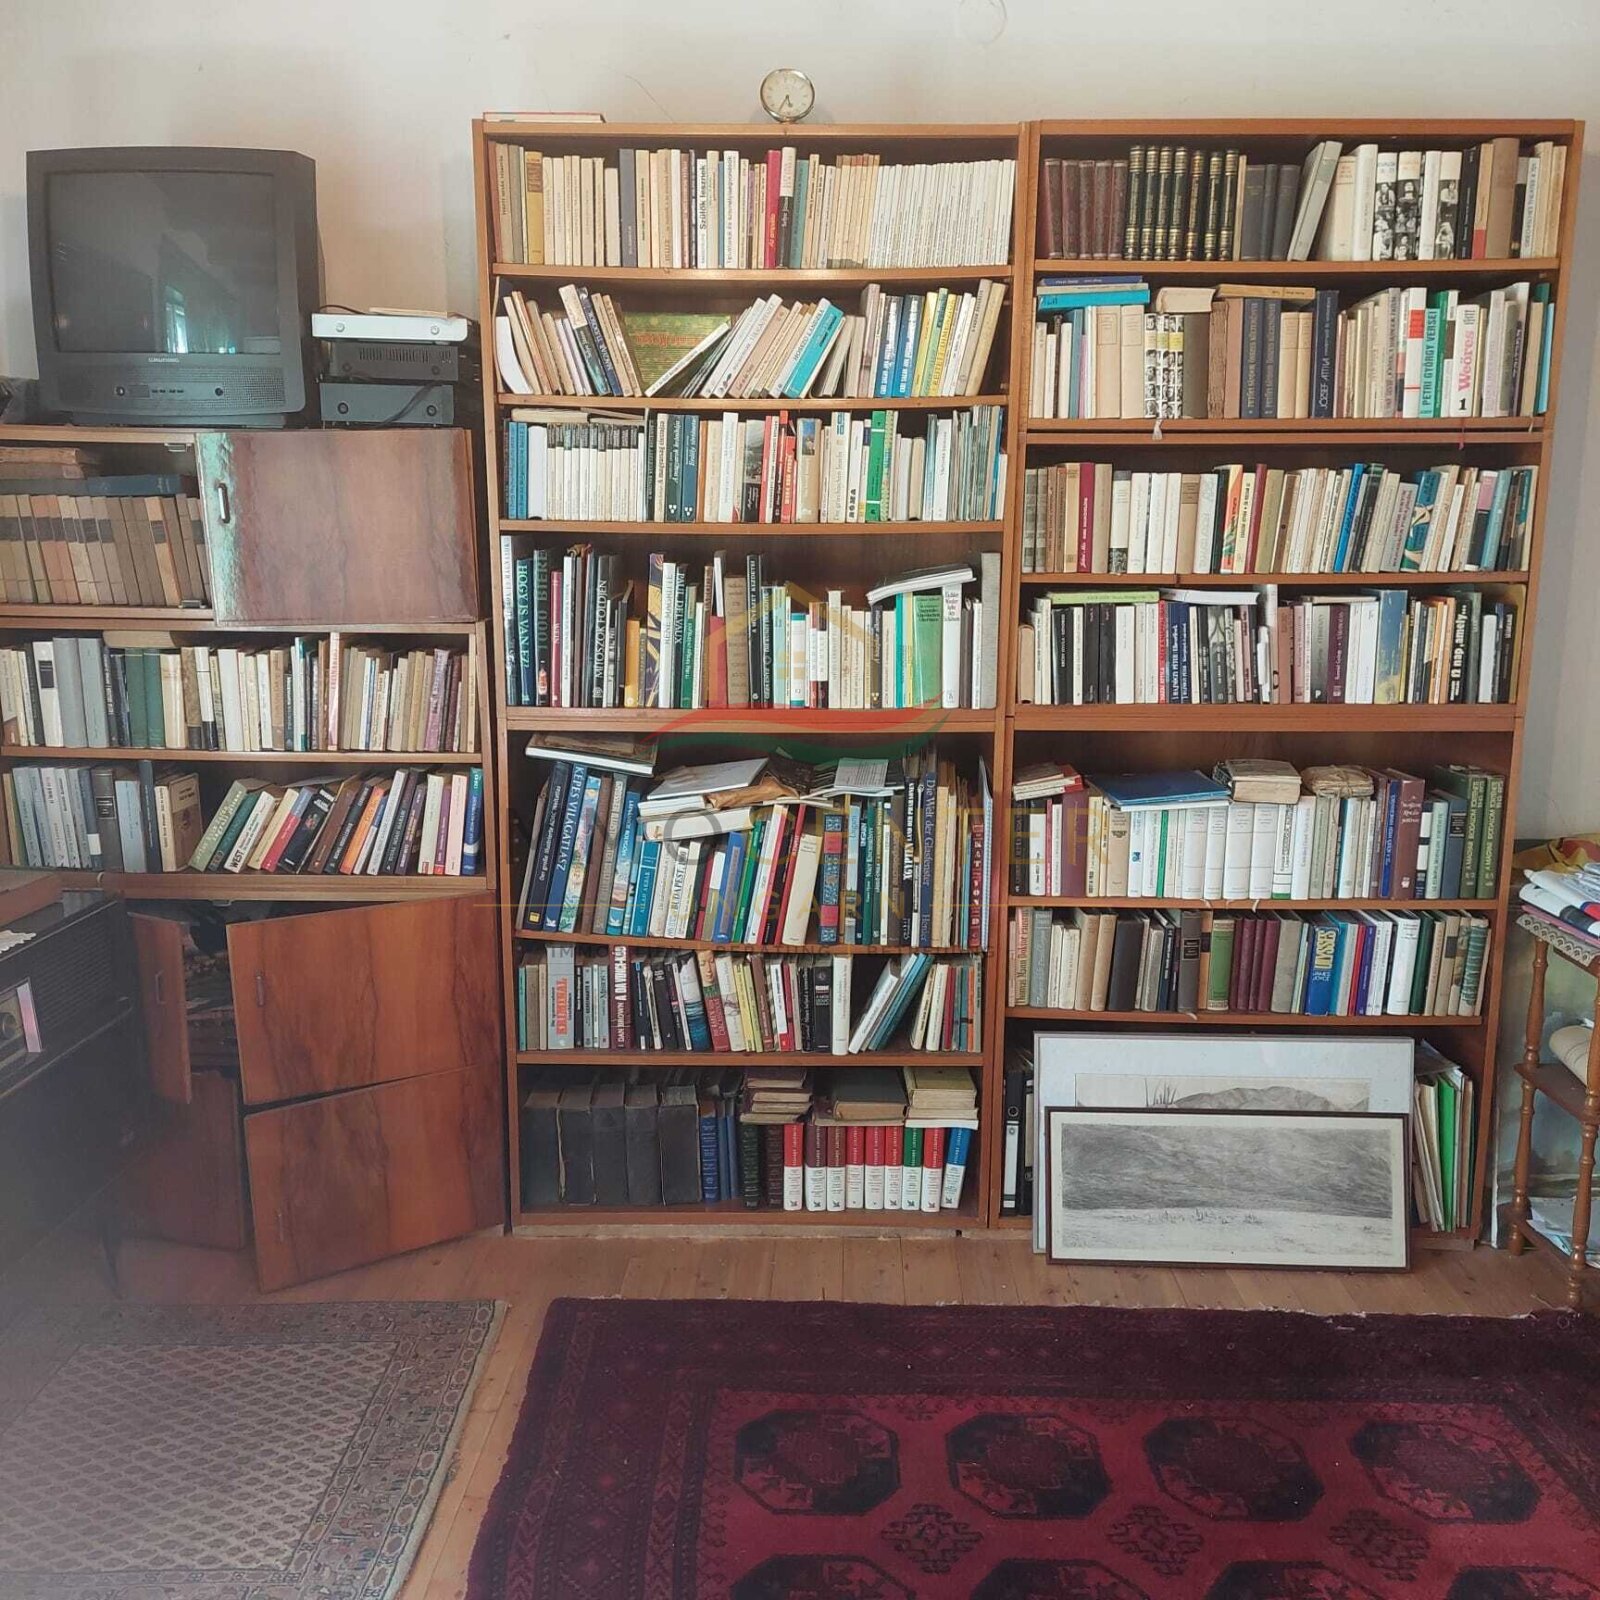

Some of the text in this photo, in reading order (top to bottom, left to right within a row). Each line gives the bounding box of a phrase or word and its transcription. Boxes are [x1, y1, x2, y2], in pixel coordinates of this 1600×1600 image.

[1422, 311, 1437, 406] PETRI GYÖRGY VERSEI
[1458, 330, 1474, 392] Weöres
[518, 565, 528, 599] HOGY
[518, 605, 528, 616] IS
[537, 551, 548, 650] 1000 BIERE
[674, 573, 685, 644] PAUL DELVAUX
[520, 620, 529, 646] VAN
[556, 766, 586, 872] KÉPES VILÁGATLASZ
[922, 779, 935, 886] Die Welt der Glasfenster
[228, 850, 244, 868] WEST
[903, 842, 913, 880] ÄGYPTEN
[1018, 937, 1028, 958] Doktor
[1314, 930, 1335, 968] ULYSSES
[1017, 960, 1027, 978] Mann
[1016, 979, 1027, 1004] Thomas
[616, 1002, 625, 1028] BROWN
[616, 1028, 624, 1043] DAN
